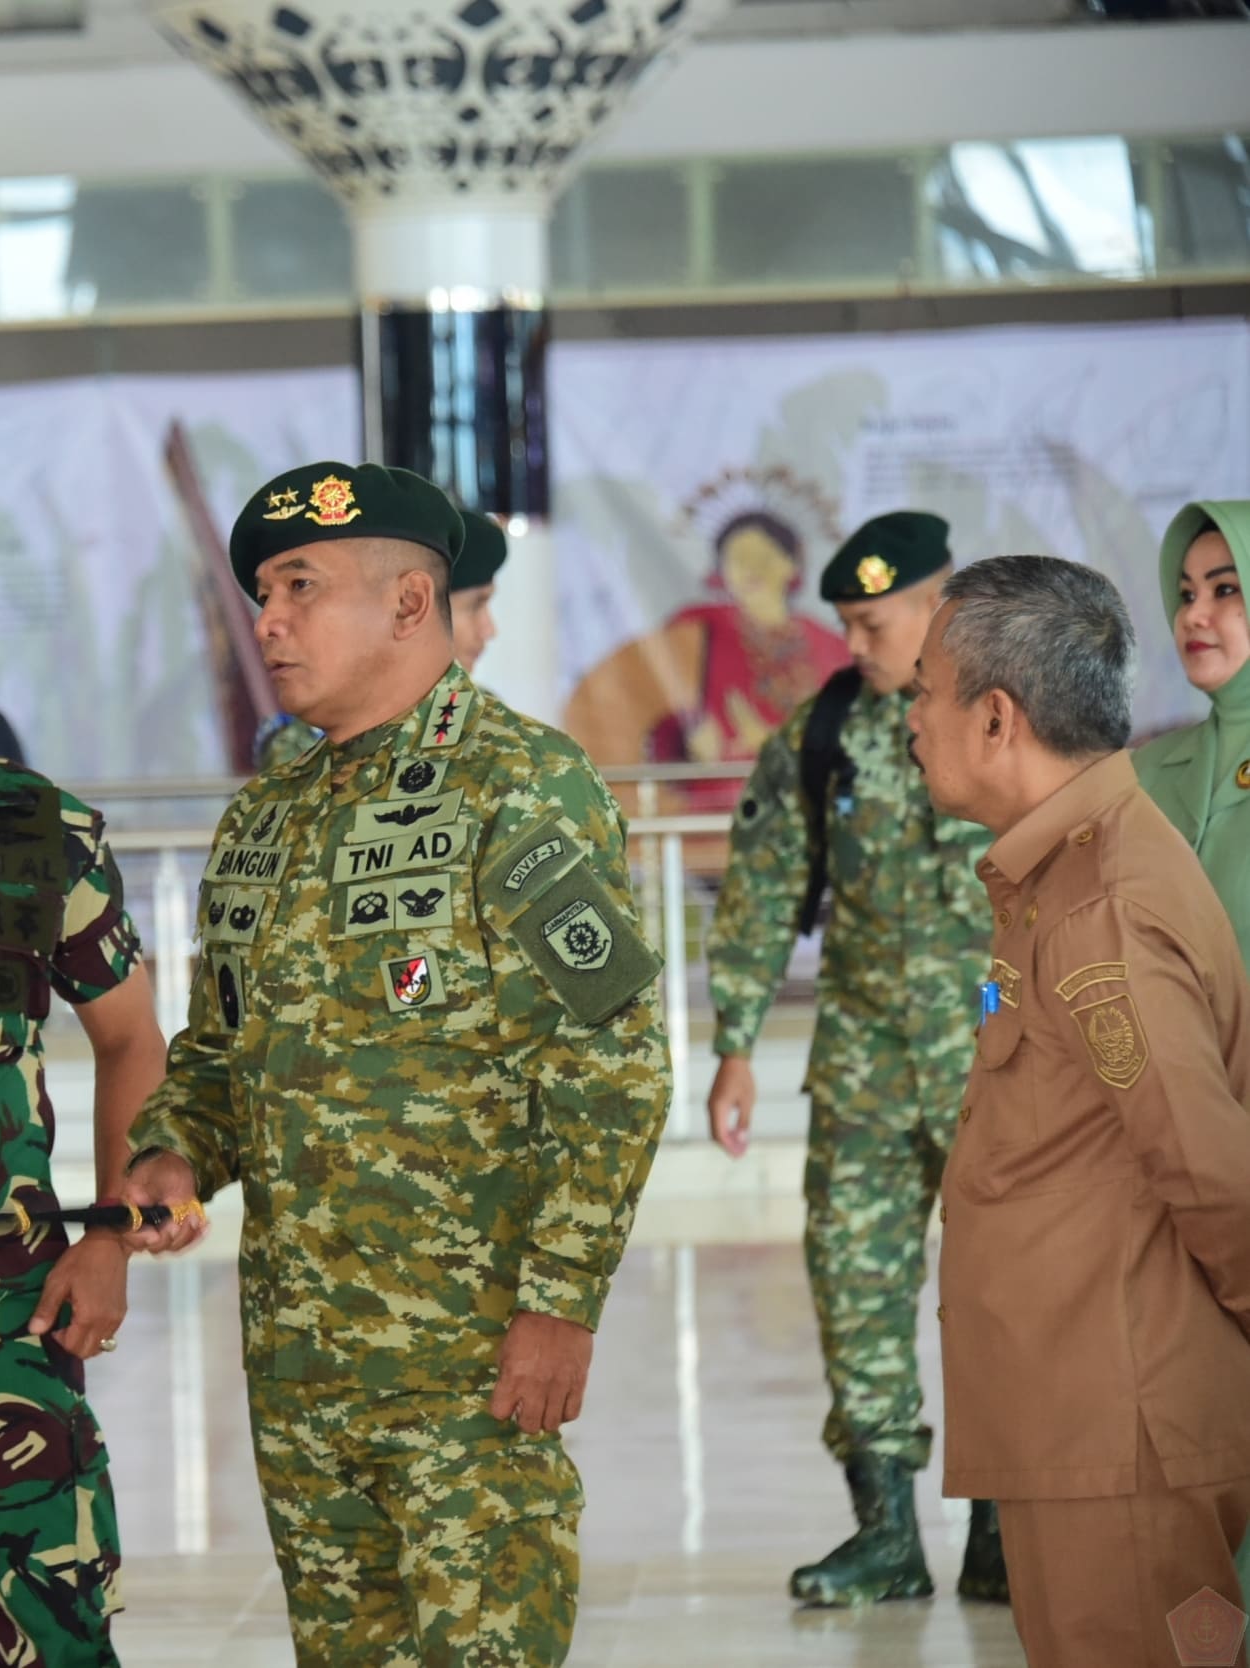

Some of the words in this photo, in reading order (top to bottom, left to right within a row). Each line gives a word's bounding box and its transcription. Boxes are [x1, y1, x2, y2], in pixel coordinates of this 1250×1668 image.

[17, 857, 58, 882] AL
[216, 849, 281, 878] BANGUN
[349, 844, 393, 874] TNI
[407, 832, 452, 861] AD
[511, 844, 556, 884] DIVIF-3
